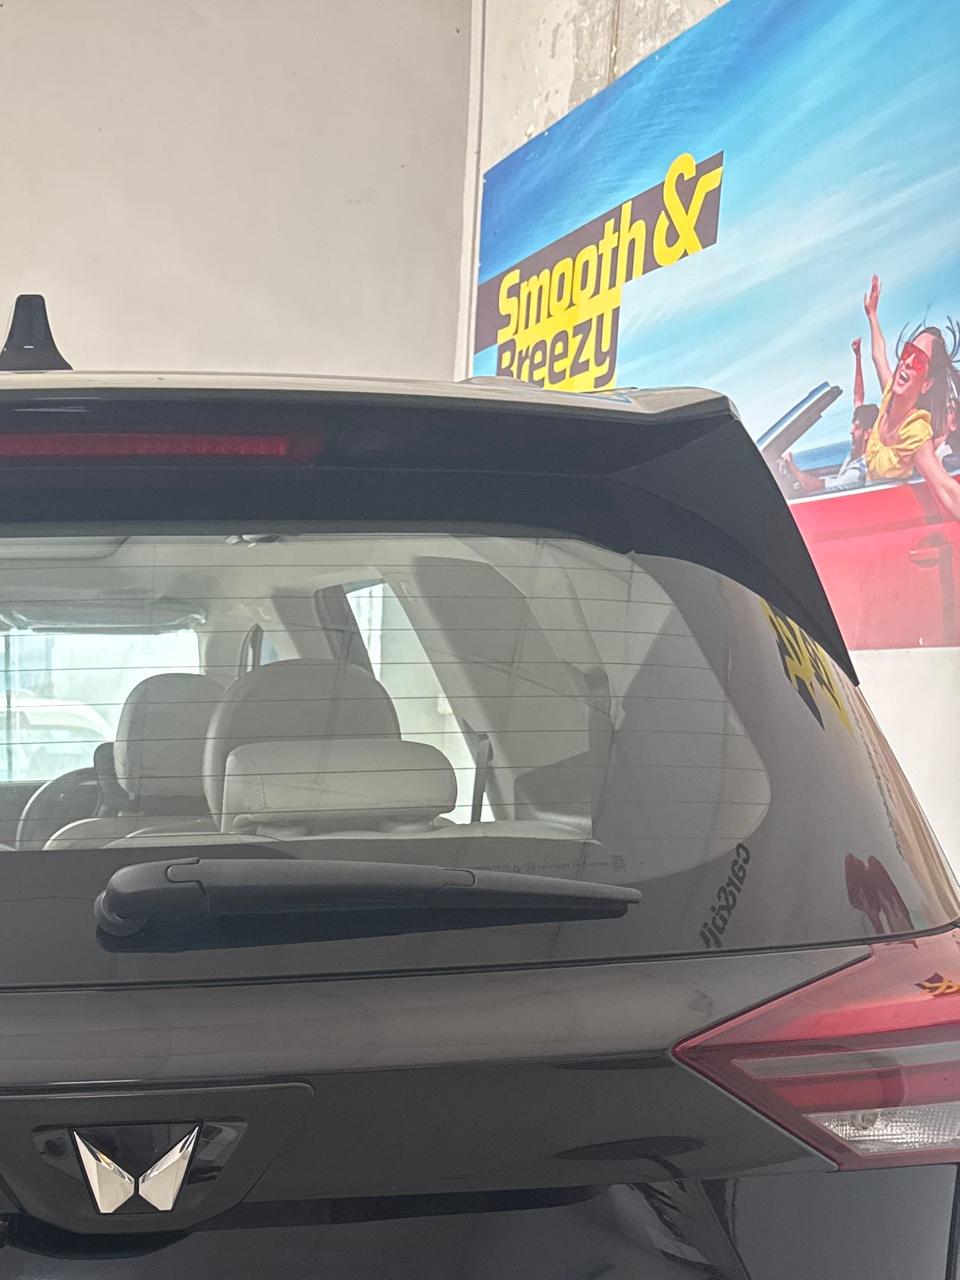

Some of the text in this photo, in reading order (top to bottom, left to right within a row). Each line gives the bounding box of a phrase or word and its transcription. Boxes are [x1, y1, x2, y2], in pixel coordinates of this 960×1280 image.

[497, 152, 724, 345] Smooth &
[496, 305, 621, 389] Breezy
